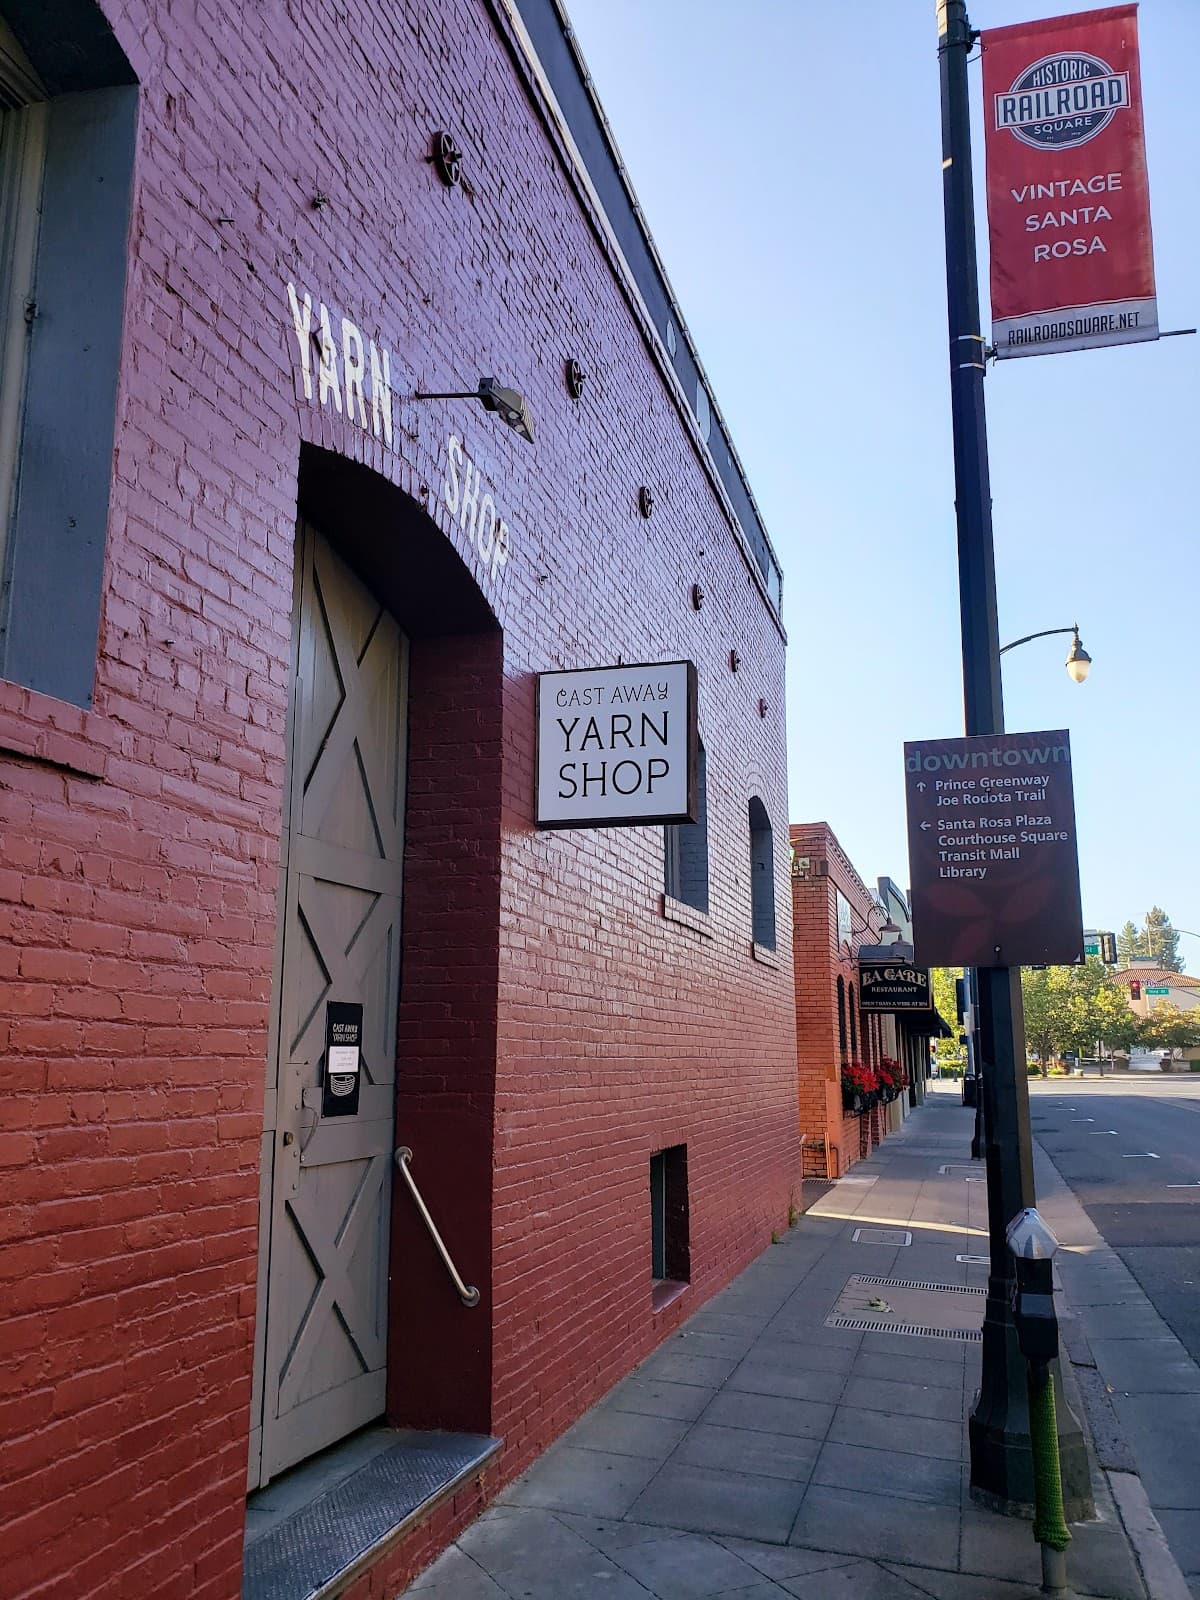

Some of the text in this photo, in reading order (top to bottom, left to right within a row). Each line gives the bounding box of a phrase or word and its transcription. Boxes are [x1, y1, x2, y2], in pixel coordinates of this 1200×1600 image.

[1033, 60, 1090, 87] HISTORIC
[1003, 79, 1122, 124] RAILROAD
[1034, 116, 1092, 135] SQUARE
[1011, 173, 1122, 203] VINTAGE
[1025, 206, 1112, 232] SANTA
[1033, 236, 1107, 263] ROSA
[1008, 311, 1140, 346] RAILROADSQUARE.NET
[287, 282, 510, 581] YARN SHOP
[556, 682, 668, 707] CAST AWAY
[556, 711, 669, 752] YARN
[906, 745, 1070, 772] downtown
[559, 759, 669, 798] SHOP
[935, 775, 1050, 791] Prince Greenway
[937, 789, 1046, 806] Joe Rodota Trail
[937, 814, 1052, 830] Santa Rosa Plaza
[938, 830, 1069, 846] Courthouse Square
[939, 847, 1020, 862] Transit Mall
[939, 866, 987, 879] Library
[883, 968, 926, 986] GARE
[333, 1023, 344, 1032] CAST
